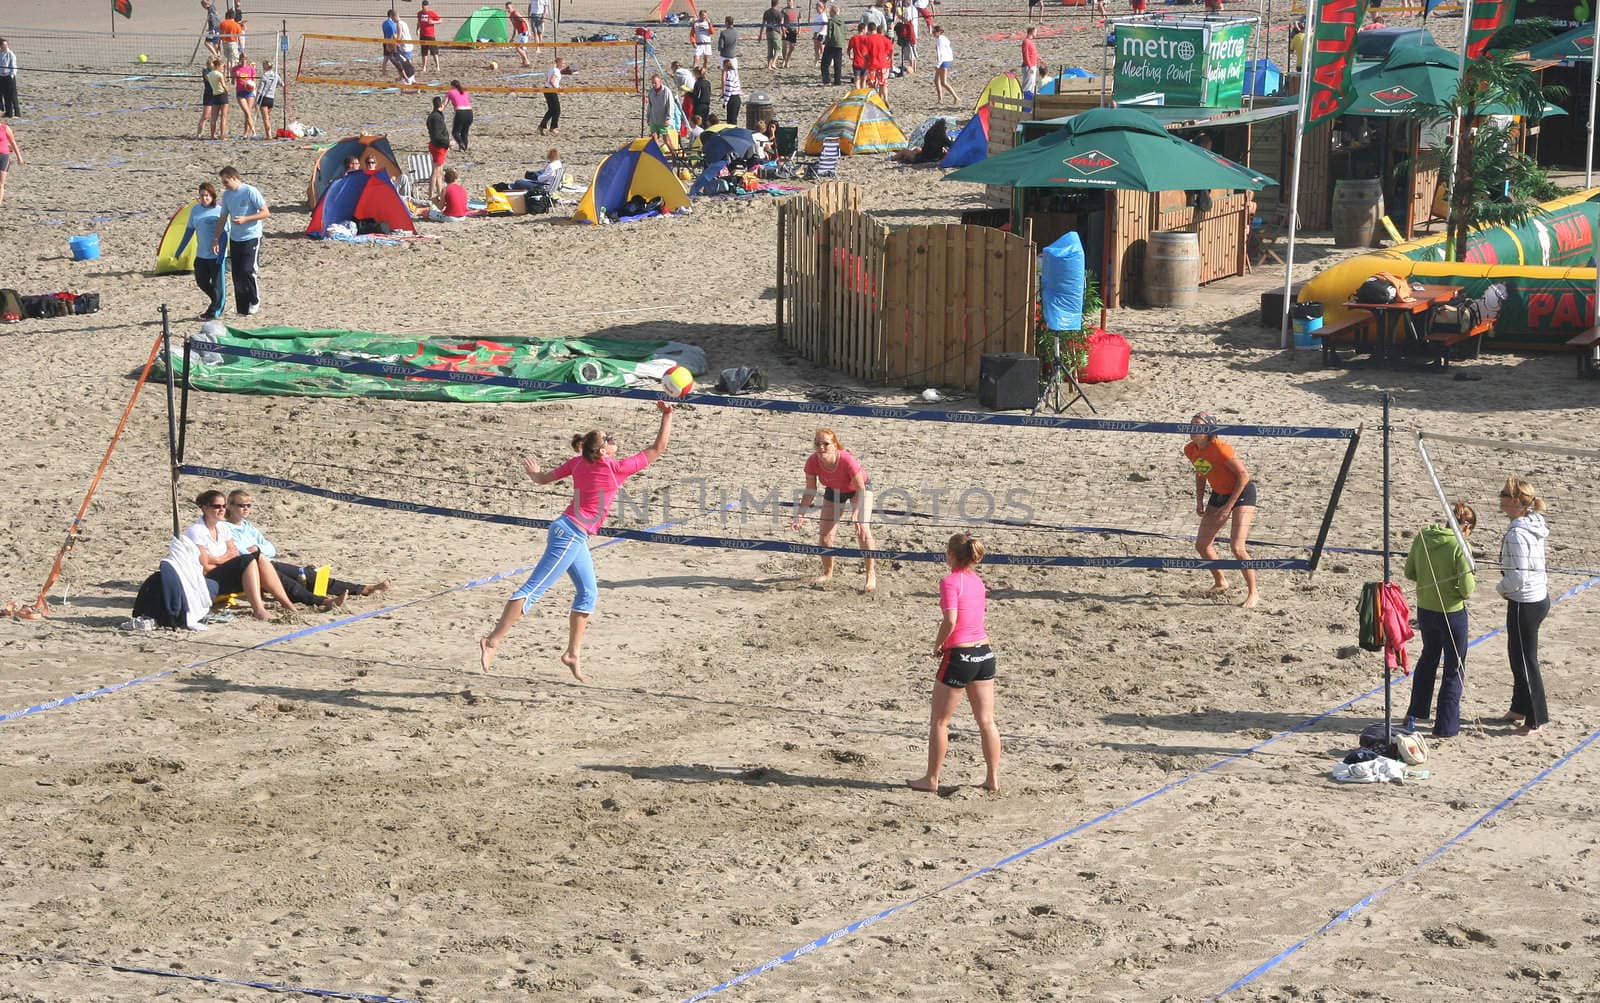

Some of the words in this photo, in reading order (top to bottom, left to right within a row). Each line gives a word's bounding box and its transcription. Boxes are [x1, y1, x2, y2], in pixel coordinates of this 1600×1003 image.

[1122, 36, 1195, 60] metro
[1209, 36, 1244, 60] metro
[1121, 59, 1162, 83] Meeting
[1166, 63, 1196, 83] Point
[251, 350, 279, 360] SPEEDO
[315, 358, 345, 368] SPEEDO
[381, 366, 412, 375] SPEEDO
[450, 373, 478, 382] SPEEDO
[518, 379, 547, 389] SPEEDO
[586, 386, 616, 395] SPEEDO
[727, 399, 758, 408] SPEEDO
[798, 403, 830, 413] SPEEDO
[871, 408, 902, 418] SPEEDO
[946, 413, 978, 422] SPEEDO
[1021, 417, 1053, 426] SPEEDO
[1098, 421, 1131, 430] SPEEDO
[1176, 423, 1210, 434] SPEEDO
[1257, 427, 1293, 437] SPEEDO
[651, 535, 680, 544] SPEEDO
[719, 539, 750, 549] SPEEDO
[788, 545, 819, 554] SPEEDO
[860, 551, 892, 559] SPEEDO
[1008, 556, 1040, 566] SPEEDO
[1083, 558, 1116, 568] SPEEDO
[1162, 559, 1195, 569] SPEEDO
[1241, 560, 1276, 570] SPEEDO
